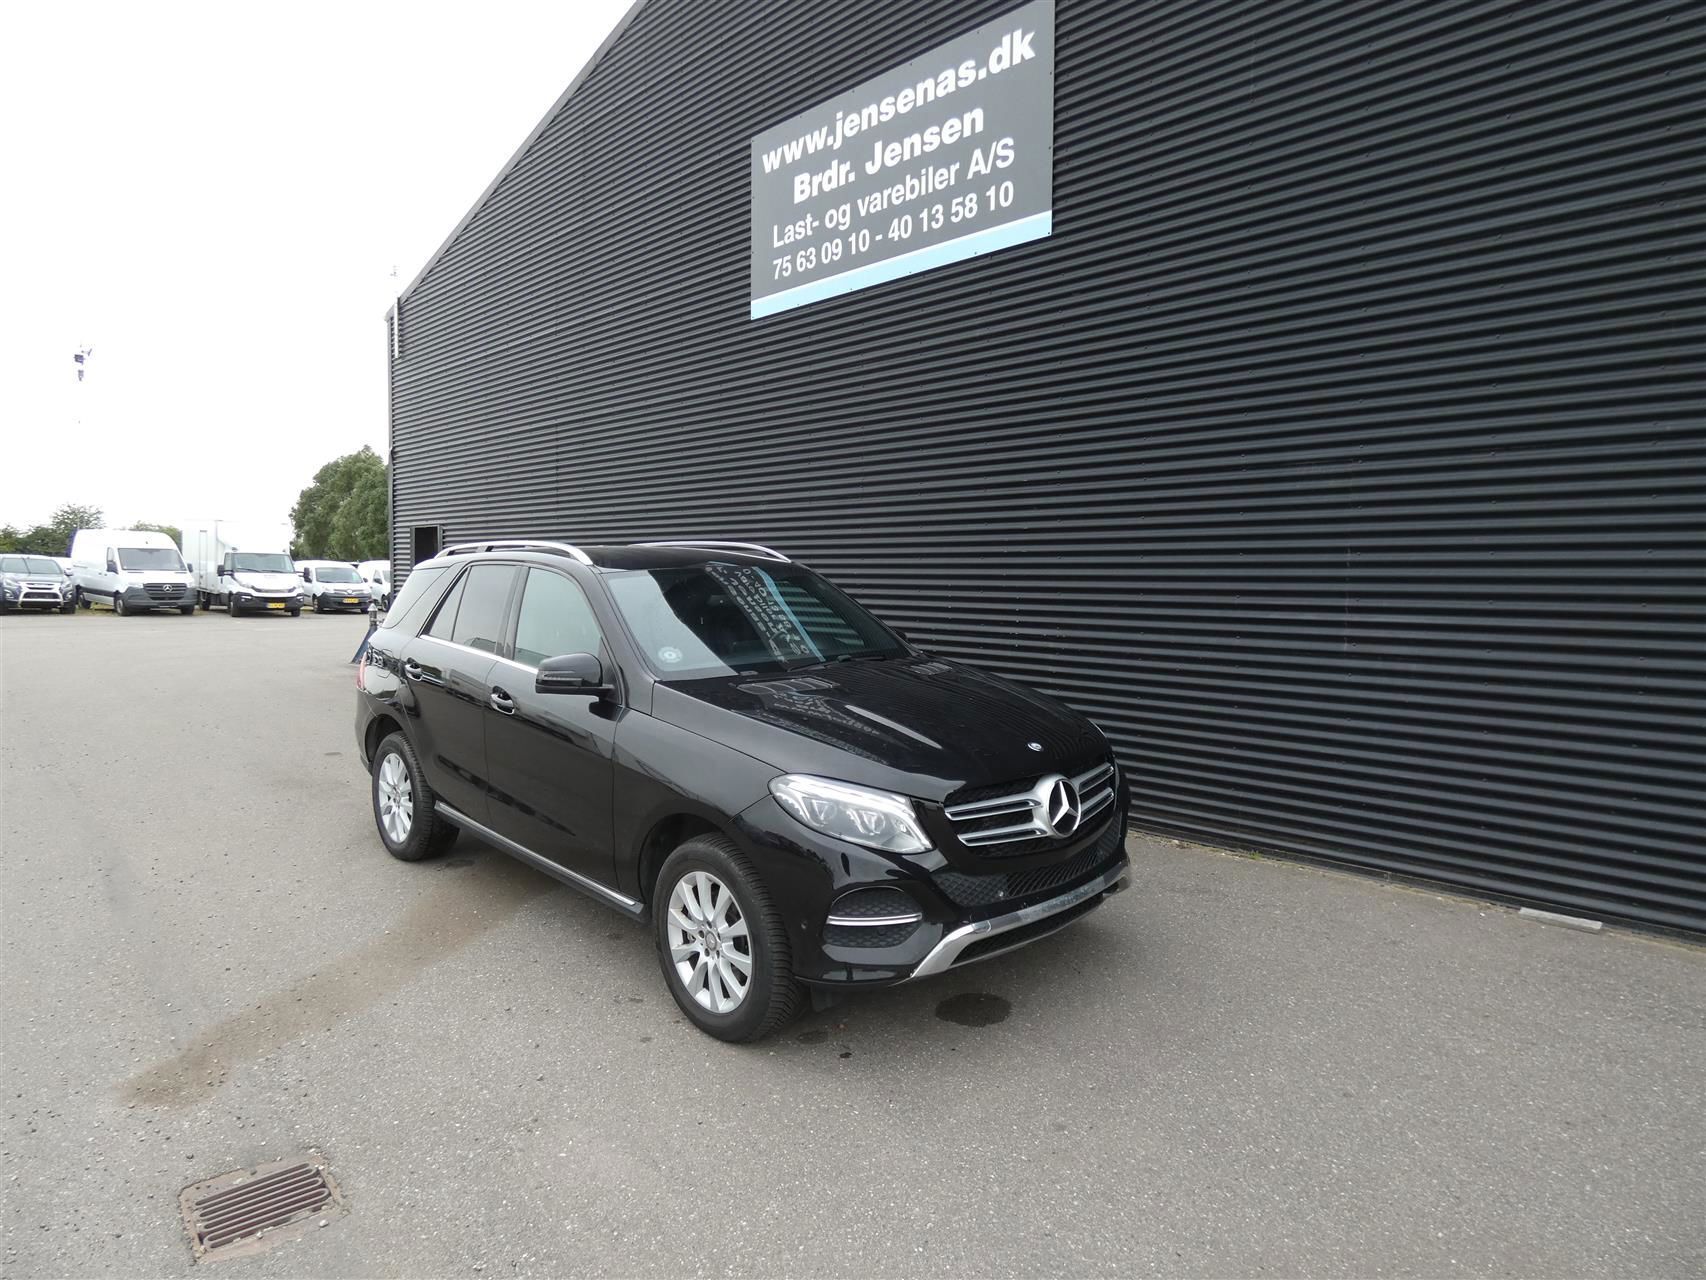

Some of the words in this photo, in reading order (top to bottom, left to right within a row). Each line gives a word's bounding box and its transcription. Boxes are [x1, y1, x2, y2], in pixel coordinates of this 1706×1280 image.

[761, 28, 1036, 174] www.jensenas.dk
[773, 213, 820, 249] Last-
[824, 203, 851, 231] og
[856, 161, 960, 217] varebiler
[966, 136, 1015, 180] A/S
[793, 159, 856, 205] Brdr.
[864, 107, 984, 175] Jensen
[772, 254, 792, 281] 75
[796, 246, 817, 273] 63
[820, 238, 843, 265] 09
[848, 228, 870, 255] 10
[887, 214, 913, 242] 40
[919, 203, 944, 233] 13
[950, 192, 978, 223] 58
[985, 180, 1014, 212] 10
